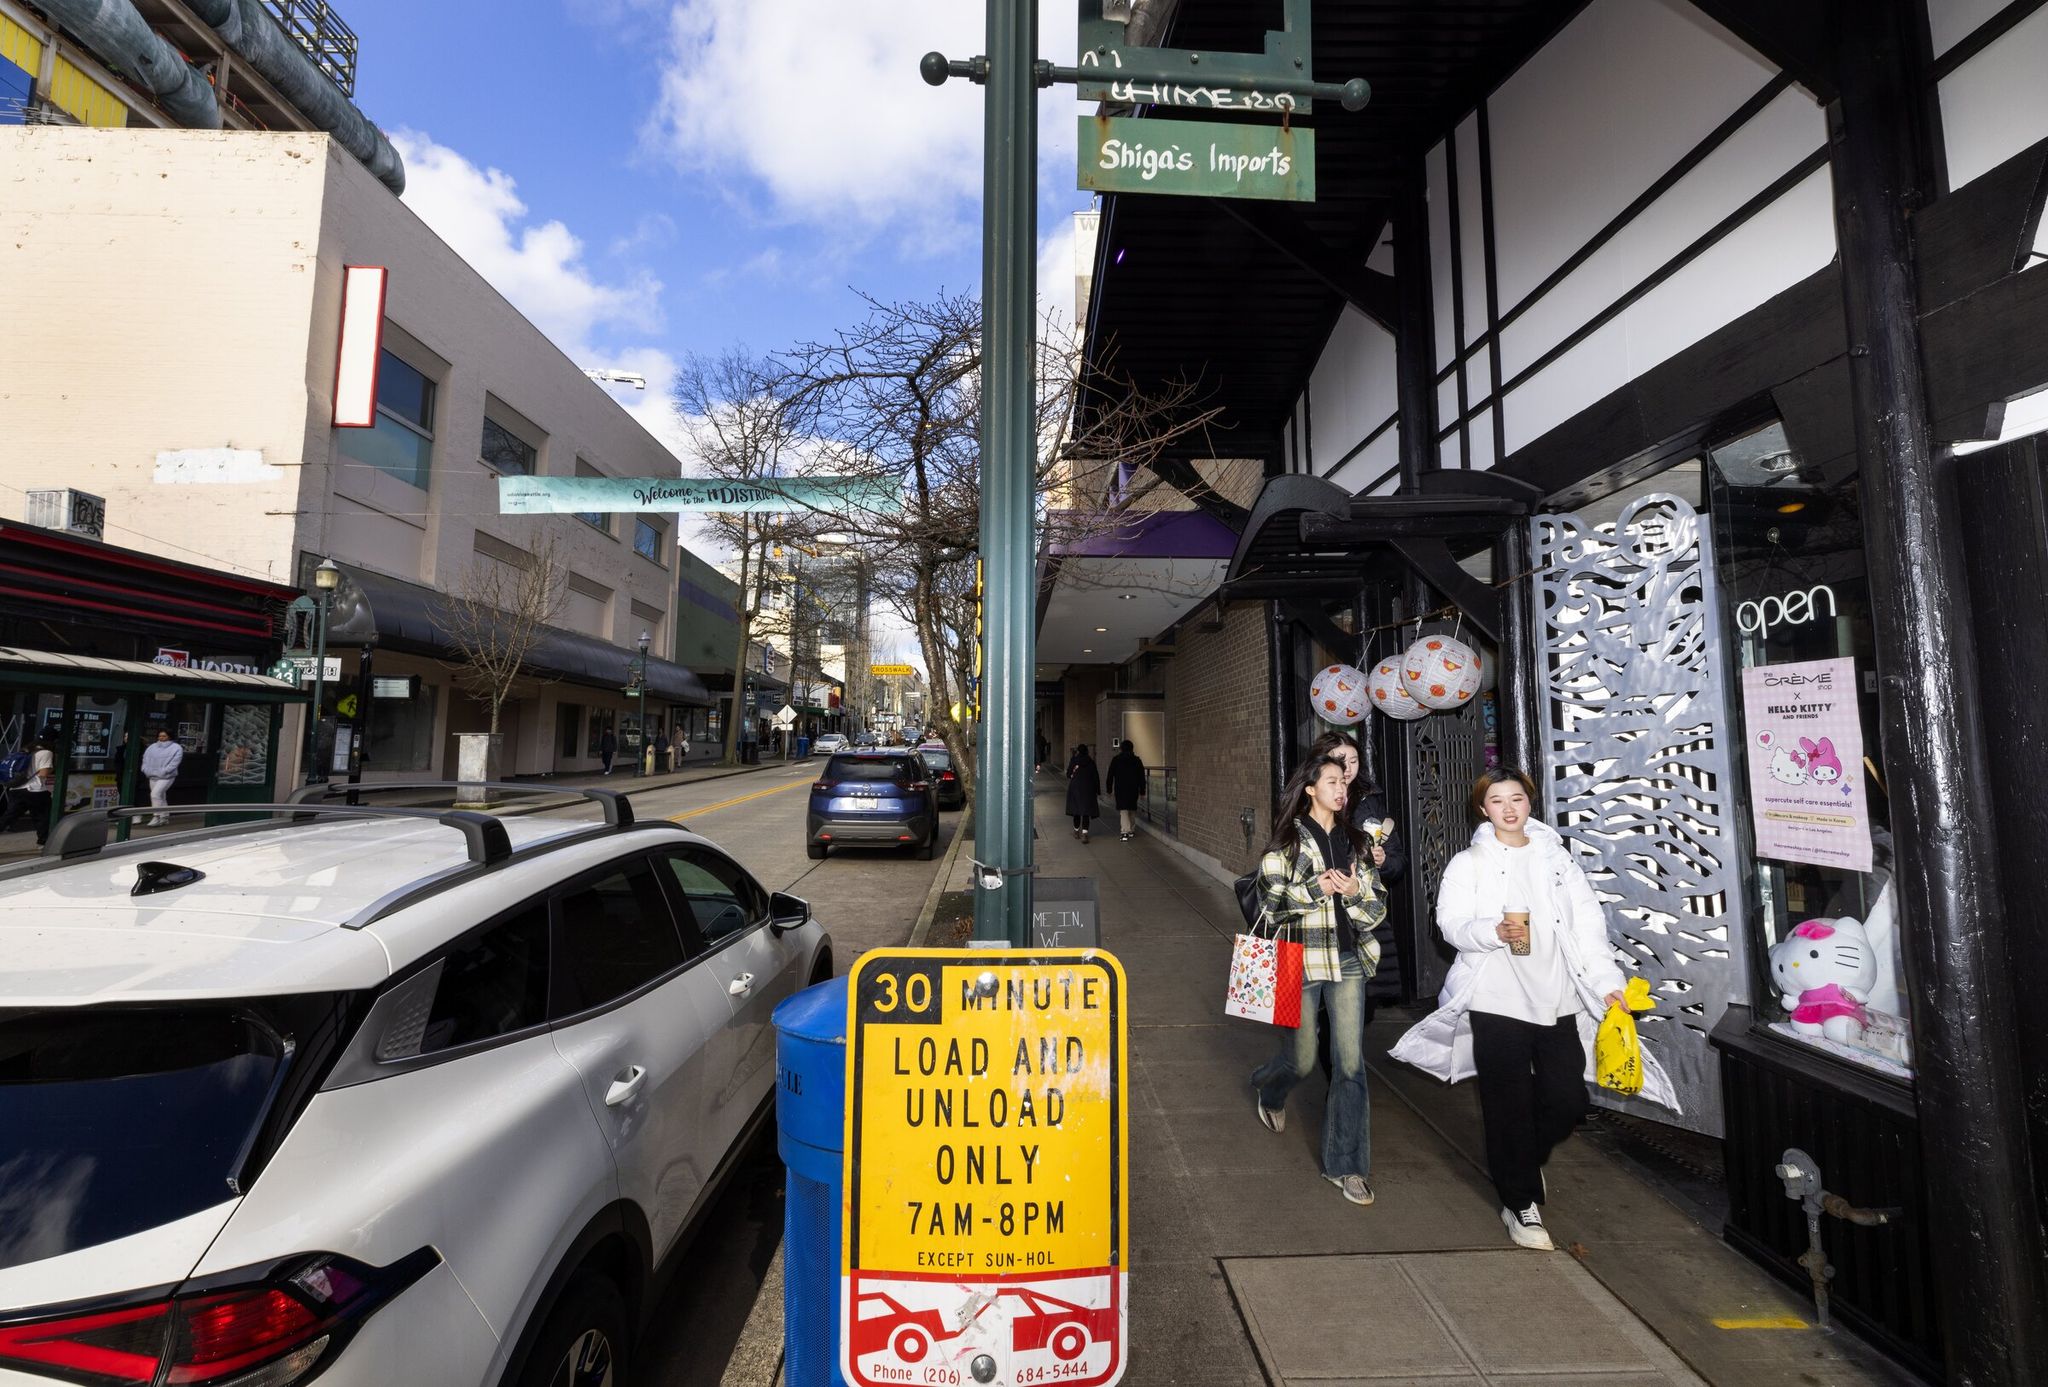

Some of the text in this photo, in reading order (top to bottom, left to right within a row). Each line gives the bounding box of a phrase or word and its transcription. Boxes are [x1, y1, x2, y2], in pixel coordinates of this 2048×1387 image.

[1099, 139, 1291, 183] Shiga's Imports
[633, 485, 693, 506] Welcome
[683, 497, 691, 505] to
[693, 496, 705, 504] the
[721, 486, 776, 504] DISTRICT
[1735, 584, 1837, 640] open
[871, 666, 912, 674] CROSSWALK
[1767, 703, 1832, 714] HELLO KITTY
[1764, 797, 1792, 805] supercute
[1040, 931, 1066, 948] WE
[874, 973, 932, 1013] 30
[894, 1036, 1084, 1076] LOAD AND
[906, 1088, 1065, 1128] UNLOAD
[936, 1144, 1040, 1185] ONLY
[907, 1200, 1064, 1237] 7AM-8PM
[917, 1251, 1055, 1267] EXCEPT SUN-HOL
[873, 1364, 913, 1381] Phone
[923, 1366, 961, 1386] (206)
[1016, 1361, 1088, 1383] 684-5444
